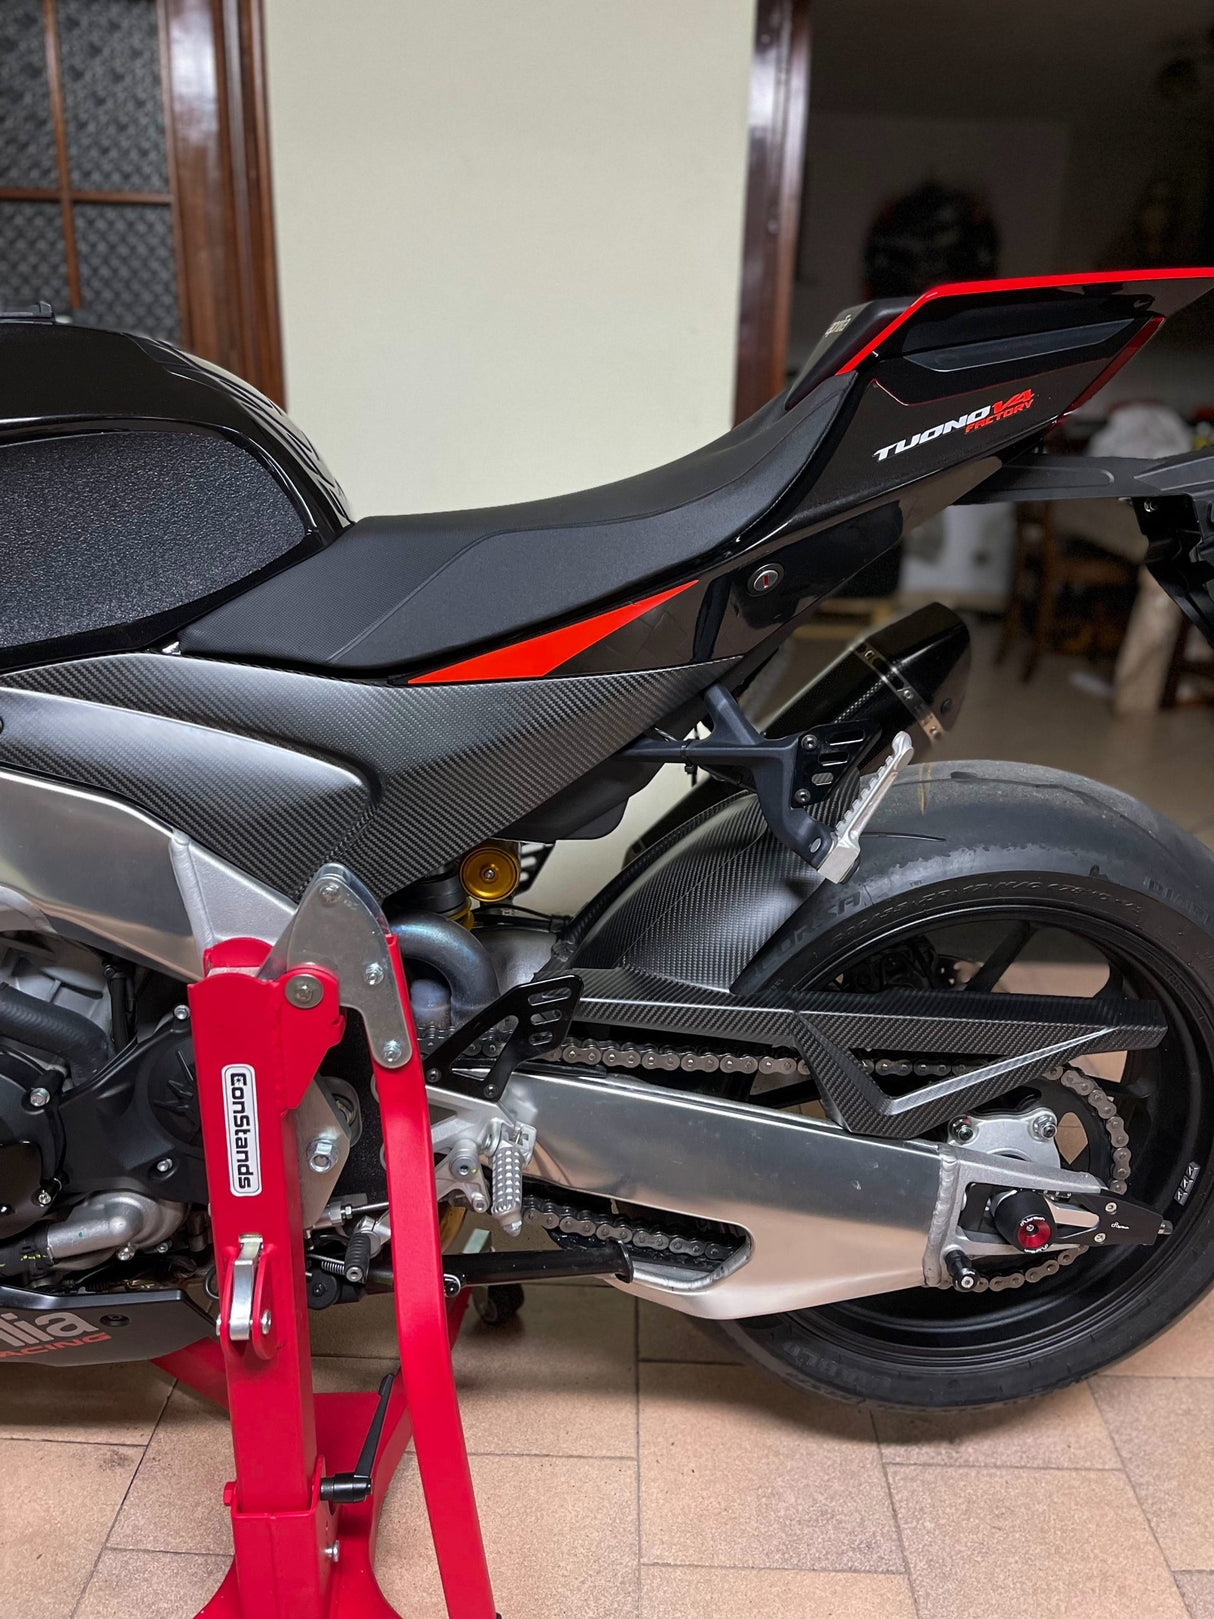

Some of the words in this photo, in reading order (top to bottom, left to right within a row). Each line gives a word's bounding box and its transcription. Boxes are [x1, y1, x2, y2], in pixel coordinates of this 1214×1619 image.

[872, 405, 991, 462] TUONO
[992, 388, 1035, 414] V4
[964, 398, 1035, 434] FACTORY
[230, 1072, 254, 1190] ConStands
